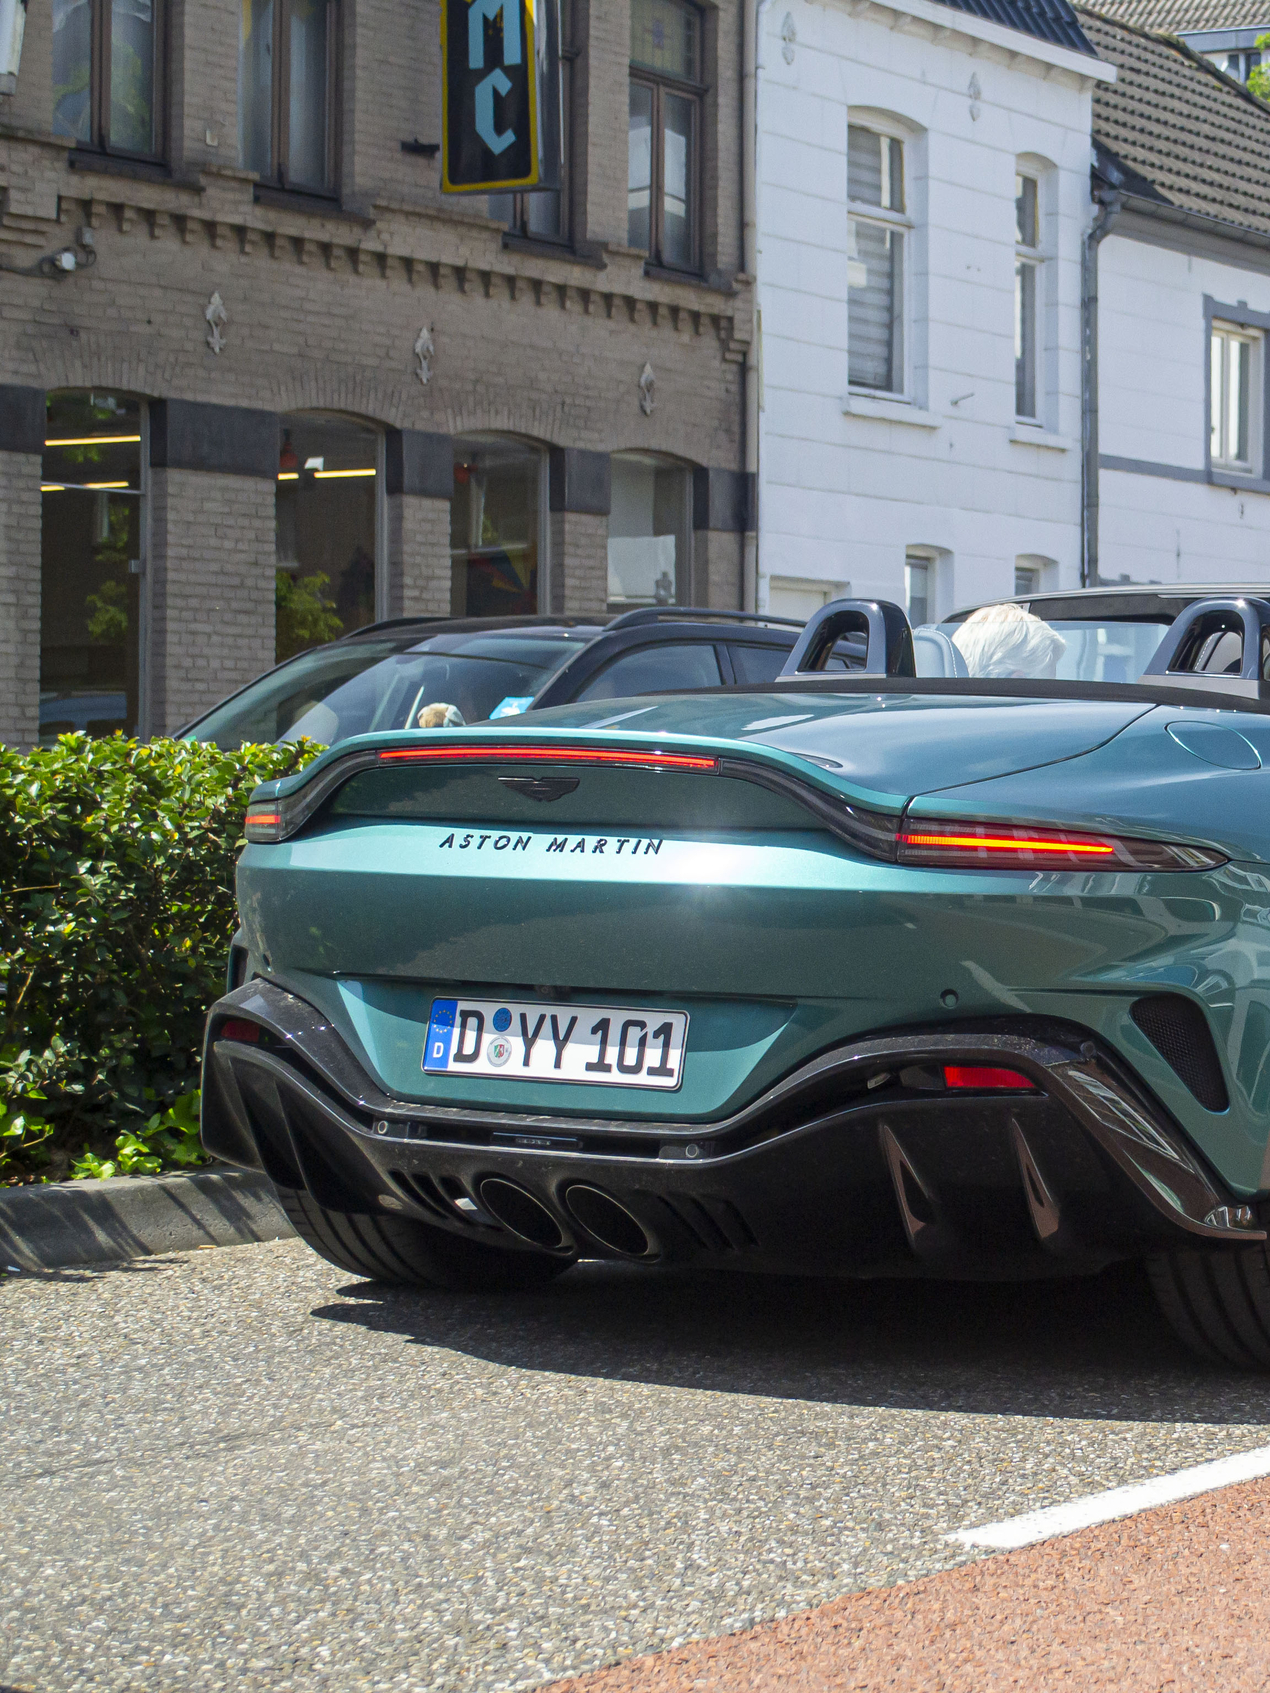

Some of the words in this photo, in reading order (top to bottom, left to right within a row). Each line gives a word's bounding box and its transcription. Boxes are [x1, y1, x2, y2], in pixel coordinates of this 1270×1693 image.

[439, 833, 532, 851] ASTON
[546, 837, 663, 854] MARTIN
[433, 1042, 444, 1058] D
[453, 1009, 485, 1063] D
[519, 1012, 578, 1070] YY
[585, 1017, 675, 1077] 101
